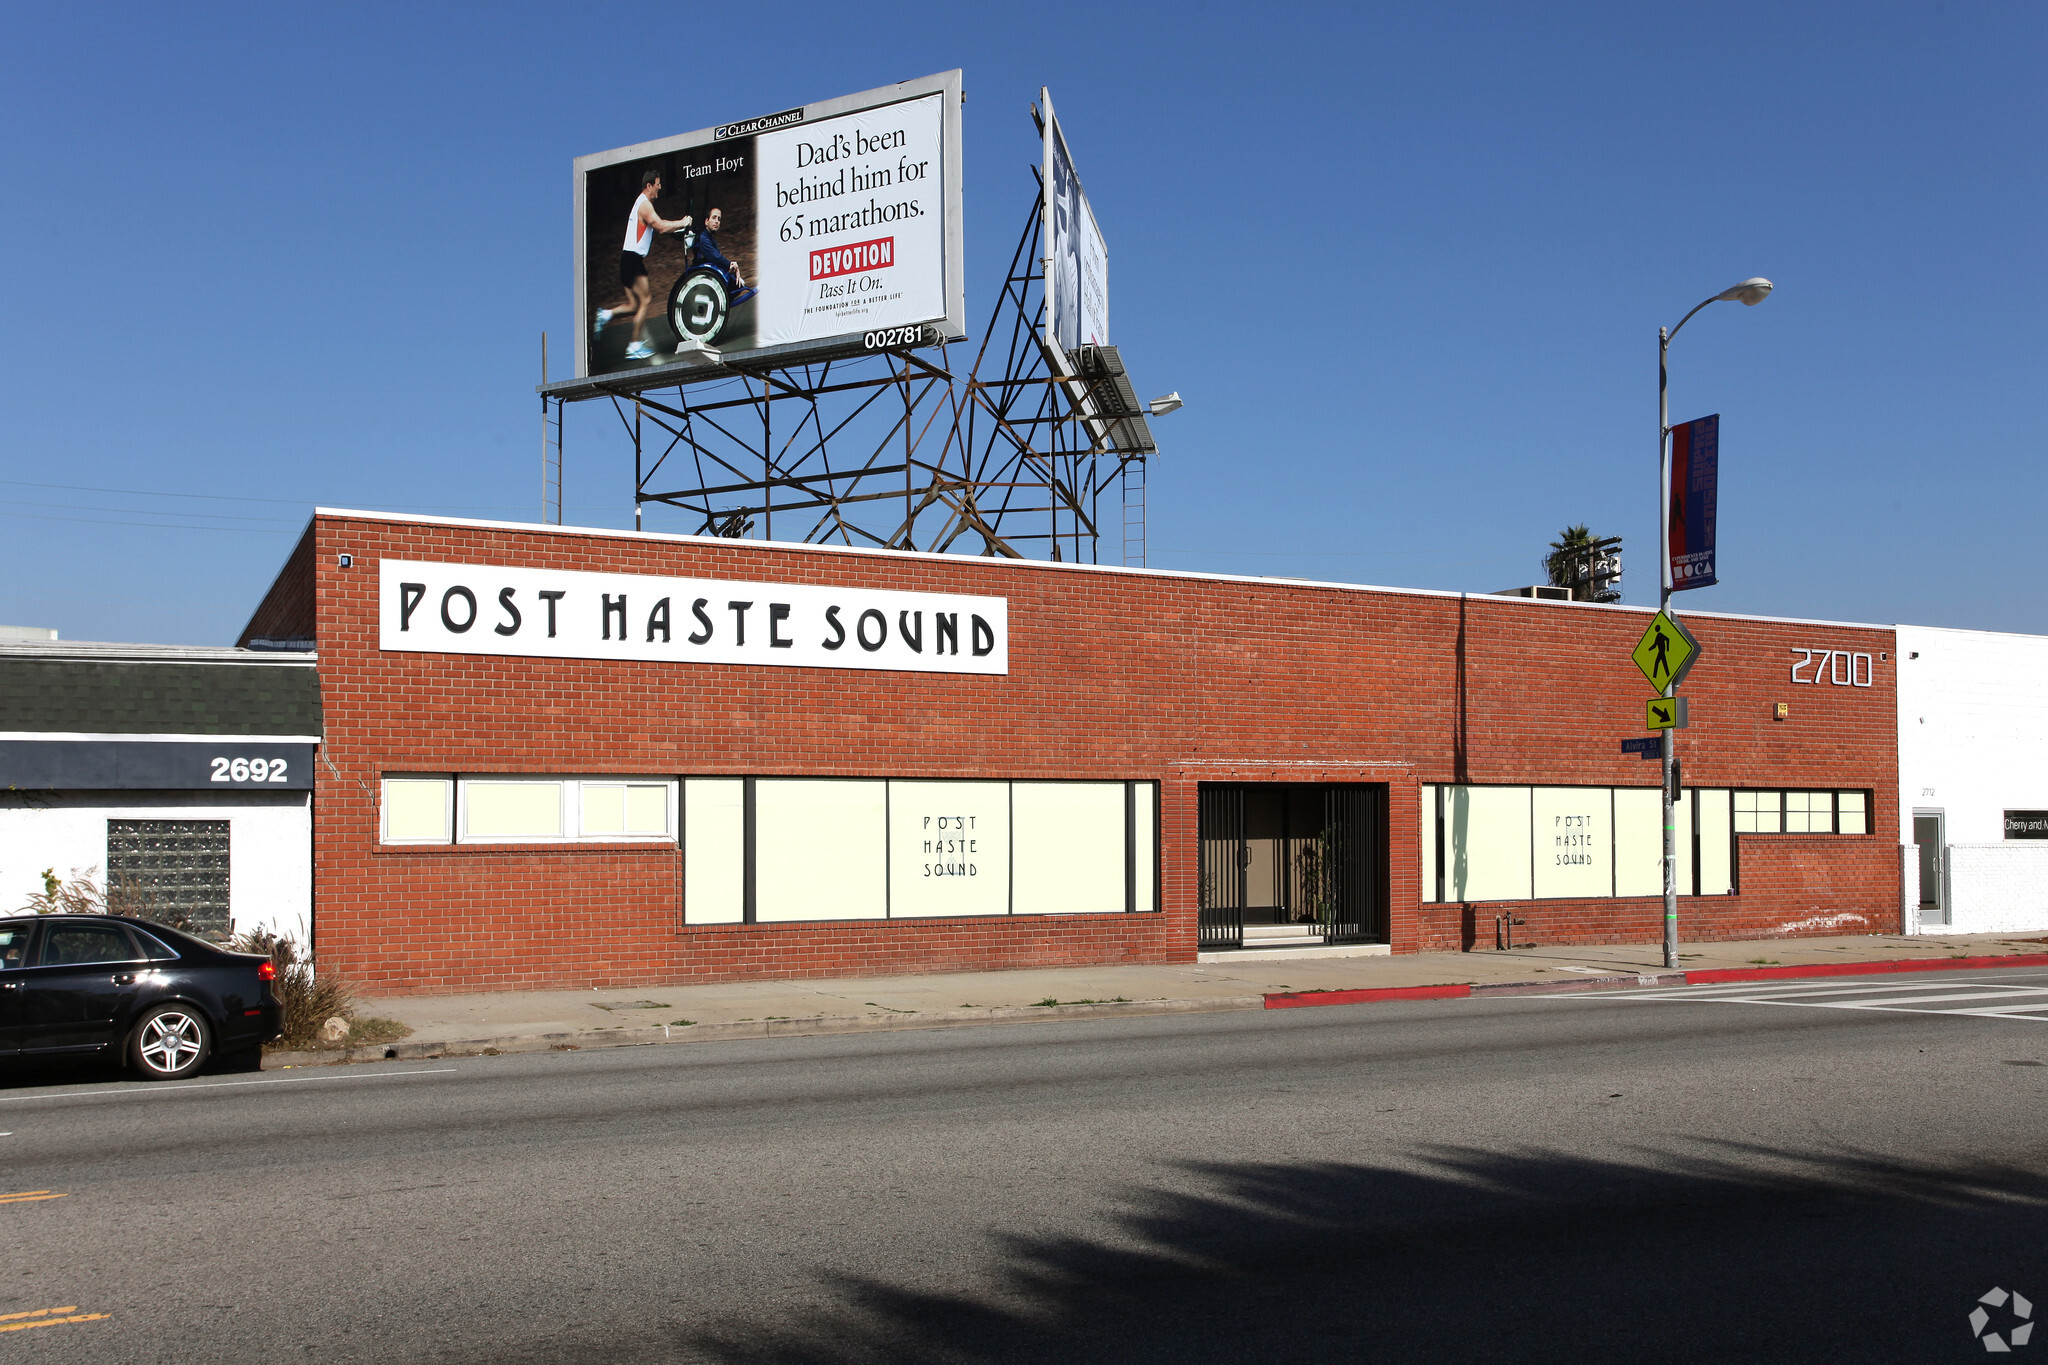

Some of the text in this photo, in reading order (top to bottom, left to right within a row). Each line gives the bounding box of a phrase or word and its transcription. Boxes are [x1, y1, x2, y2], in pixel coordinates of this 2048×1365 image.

[796, 129, 907, 169] Dad's been
[682, 156, 744, 179] Team Hoyt
[776, 155, 929, 208] behind him for
[779, 198, 925, 242] 65 marathons.
[812, 241, 891, 276] DEVOTION
[819, 282, 844, 299] Pass
[846, 278, 857, 294] It
[815, 301, 849, 313] FOUNDATION
[868, 294, 887, 304] BETTER
[864, 325, 923, 349] 002781
[399, 582, 995, 657] POST HASTE SOUND
[1790, 647, 1873, 687] 2700
[1625, 739, 1657, 751] Alvira St
[210, 757, 287, 782] 2692
[924, 816, 977, 829] POST
[1556, 816, 1591, 827] POST
[2004, 818, 2028, 833] Cherry
[2028, 818, 2043, 831] and
[924, 840, 977, 853] HASTE
[1556, 835, 1591, 846] HASTE
[924, 863, 977, 876] SOUND
[1556, 854, 1591, 865] SOUND
